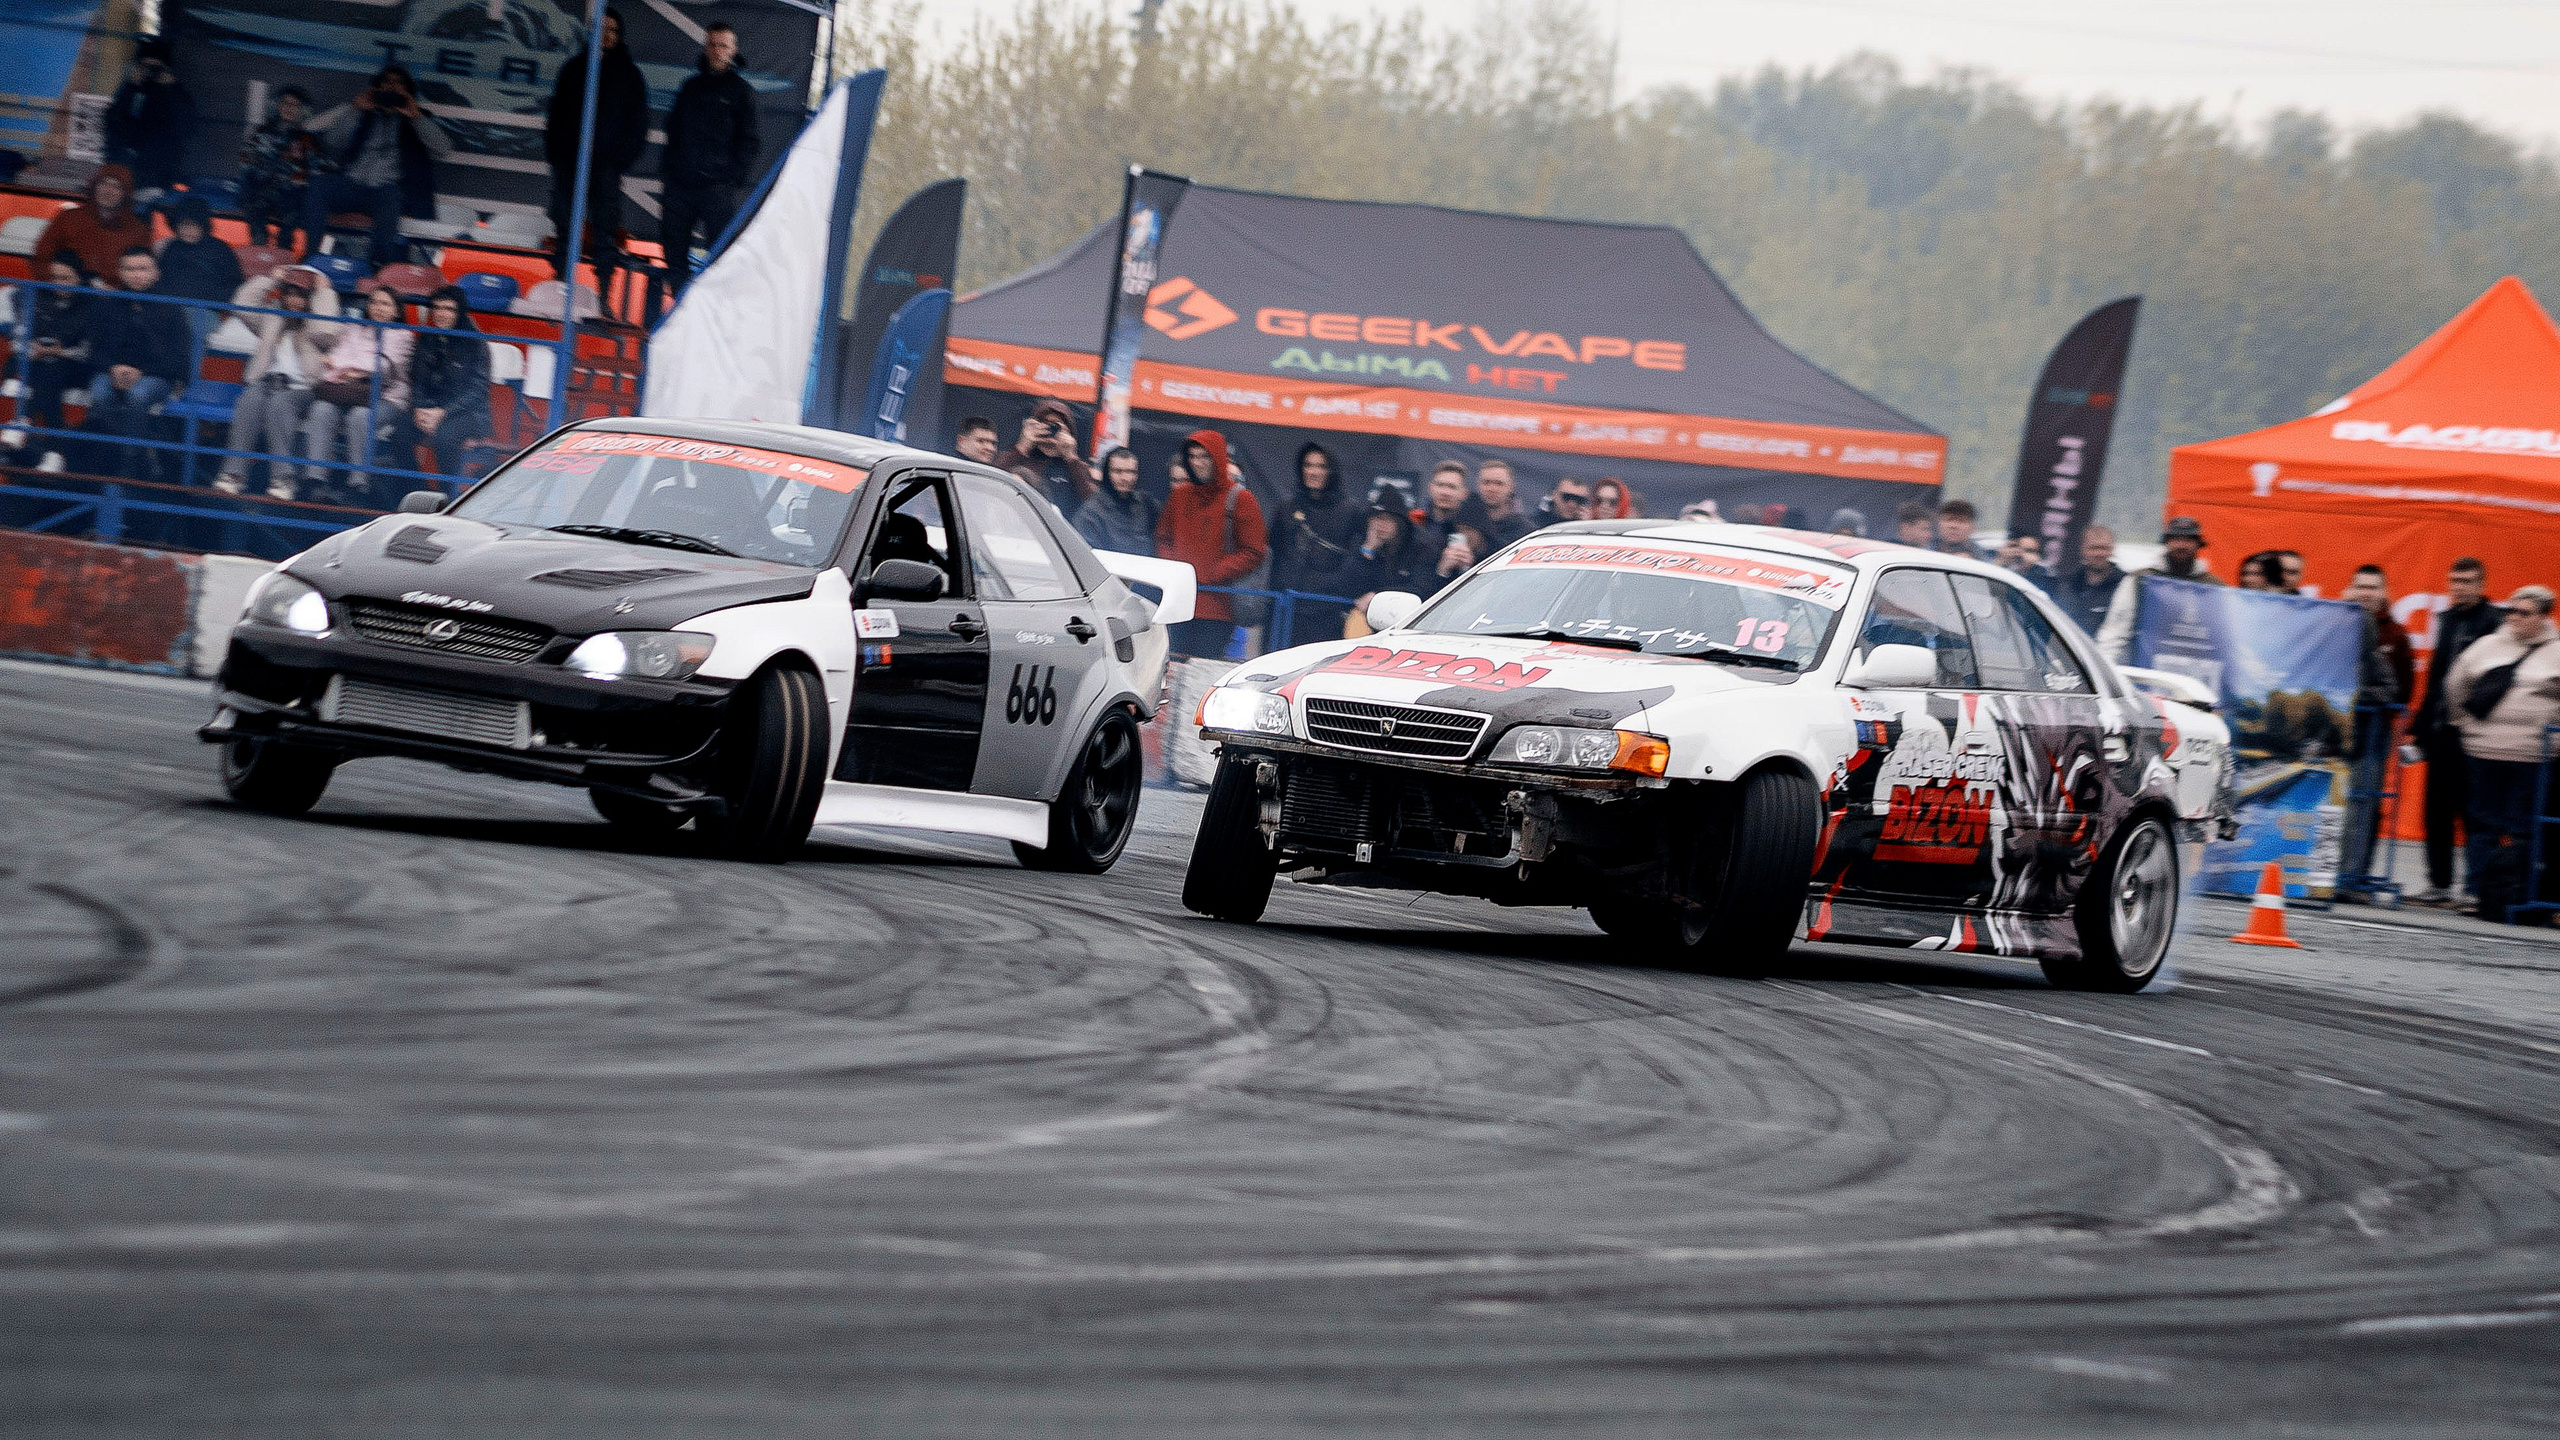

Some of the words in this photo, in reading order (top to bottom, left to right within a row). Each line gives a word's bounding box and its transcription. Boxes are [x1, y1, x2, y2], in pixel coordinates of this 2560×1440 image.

[1256, 306, 1686, 371] GEEKVAPE
[1466, 363, 1567, 393] НЕТ
[1733, 617, 1789, 653] 13
[1329, 646, 1552, 690] BIZON
[1006, 663, 1057, 726] 666
[1879, 784, 1995, 845] BIZON
